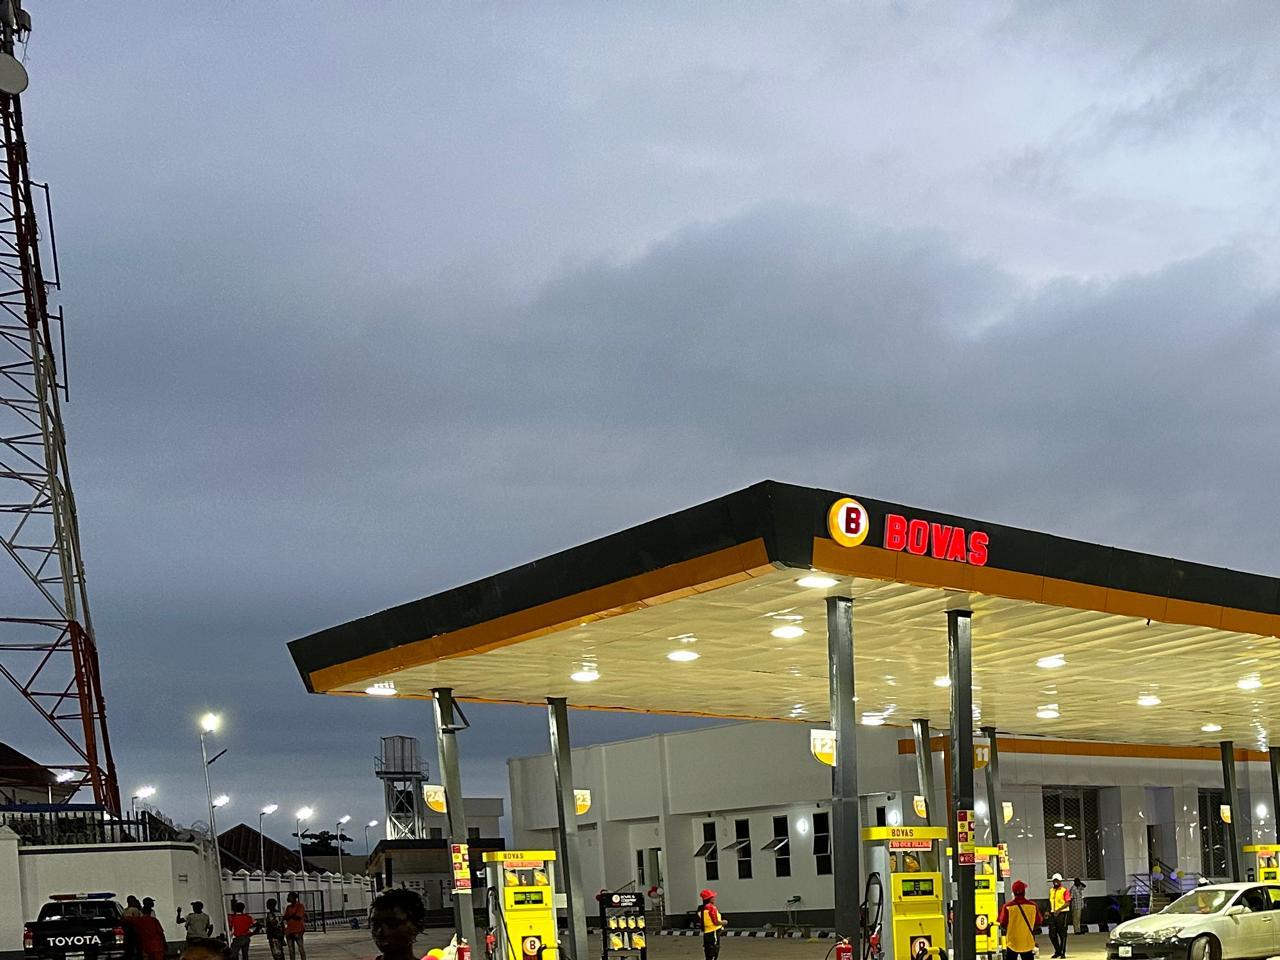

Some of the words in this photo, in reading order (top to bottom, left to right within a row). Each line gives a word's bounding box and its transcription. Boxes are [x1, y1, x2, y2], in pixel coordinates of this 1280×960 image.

[845, 506, 861, 534] B
[884, 513, 989, 566] BOVAS
[813, 737, 833, 753] 12
[975, 747, 989, 761] 11
[426, 791, 444, 802] 24
[891, 828, 914, 837] BOVAS
[46, 935, 102, 947] TOYOTA
[529, 939, 536, 950] B
